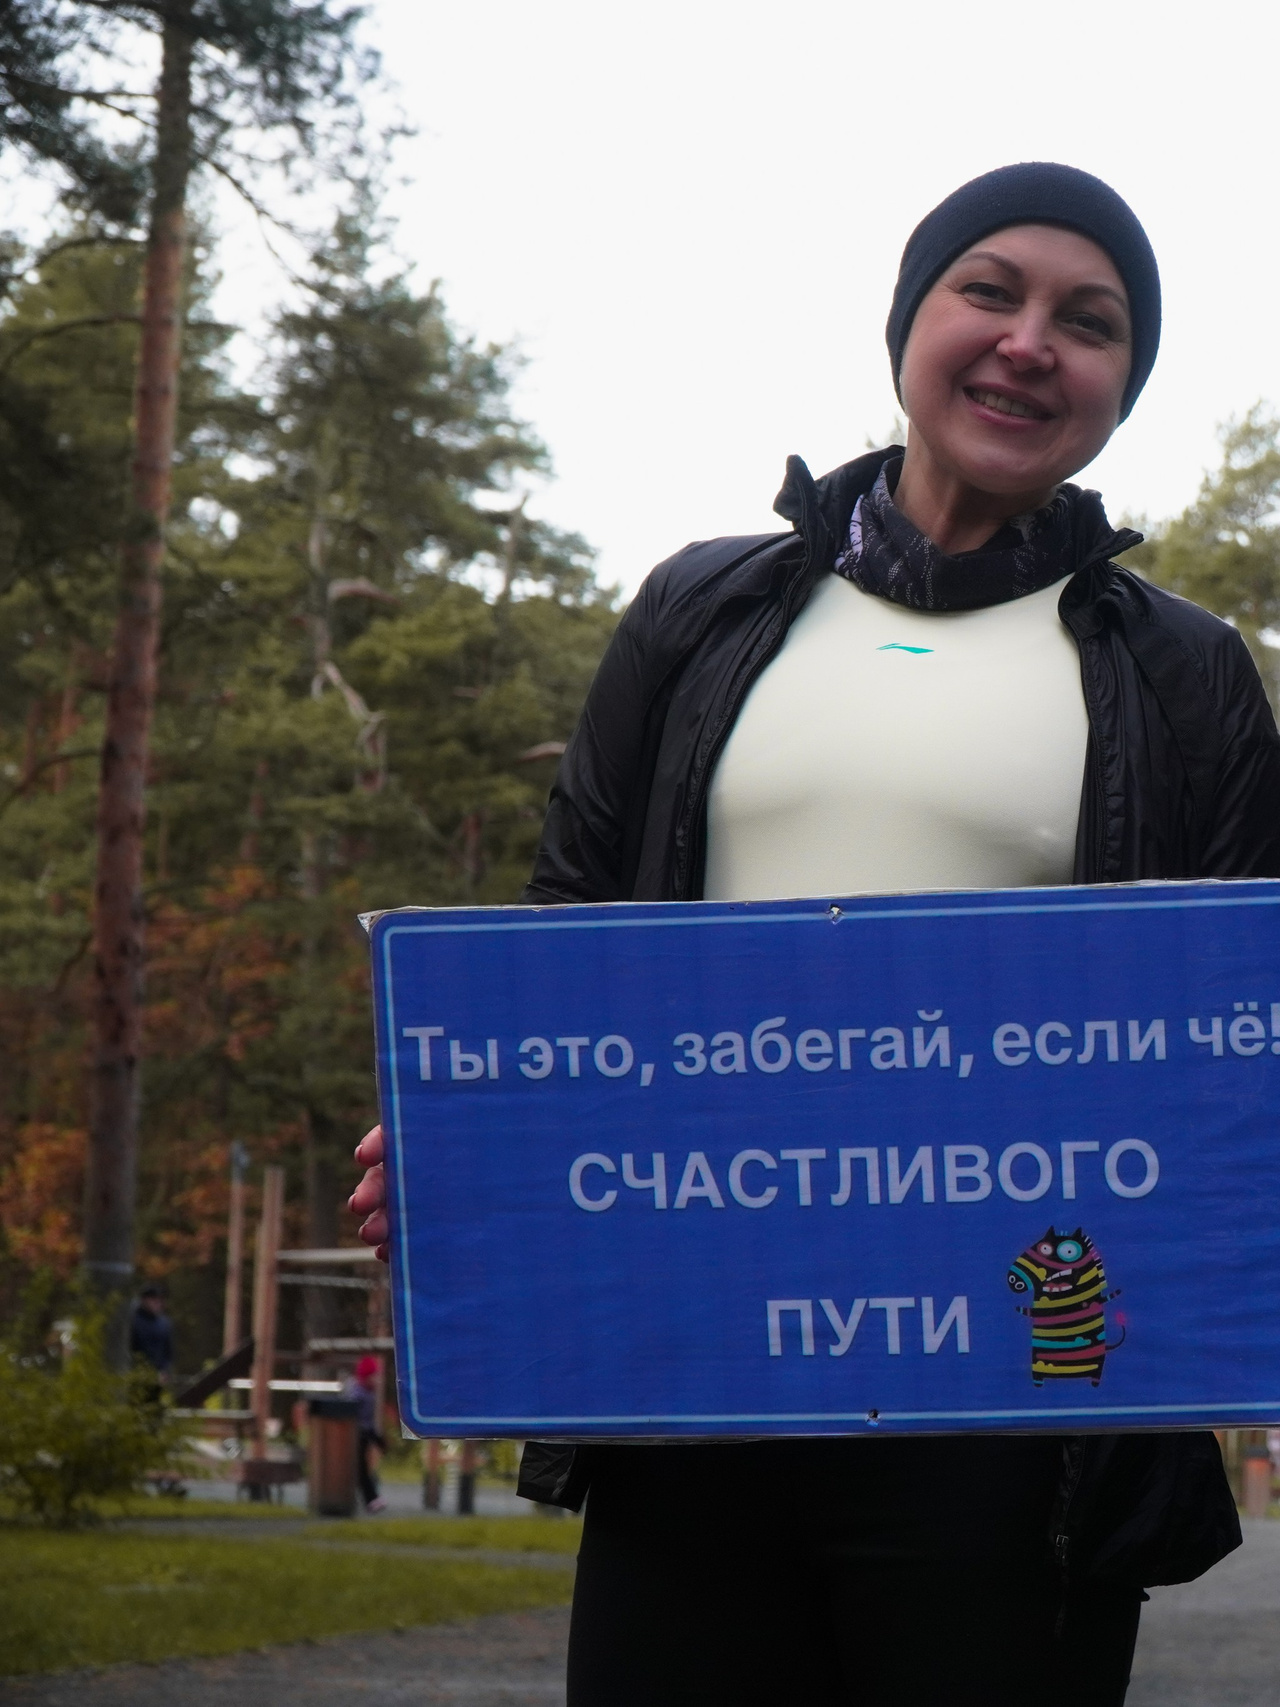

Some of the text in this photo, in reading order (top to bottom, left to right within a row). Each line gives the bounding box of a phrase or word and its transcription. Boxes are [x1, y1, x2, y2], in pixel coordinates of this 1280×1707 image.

[405, 1026, 499, 1080] Ты
[520, 1034, 655, 1086] это,
[674, 1009, 974, 1078] забегай,
[993, 1019, 1166, 1066] если
[569, 1138, 1160, 1211] СЧАСТЛИВОГО
[767, 1296, 970, 1356] ПУТИ
